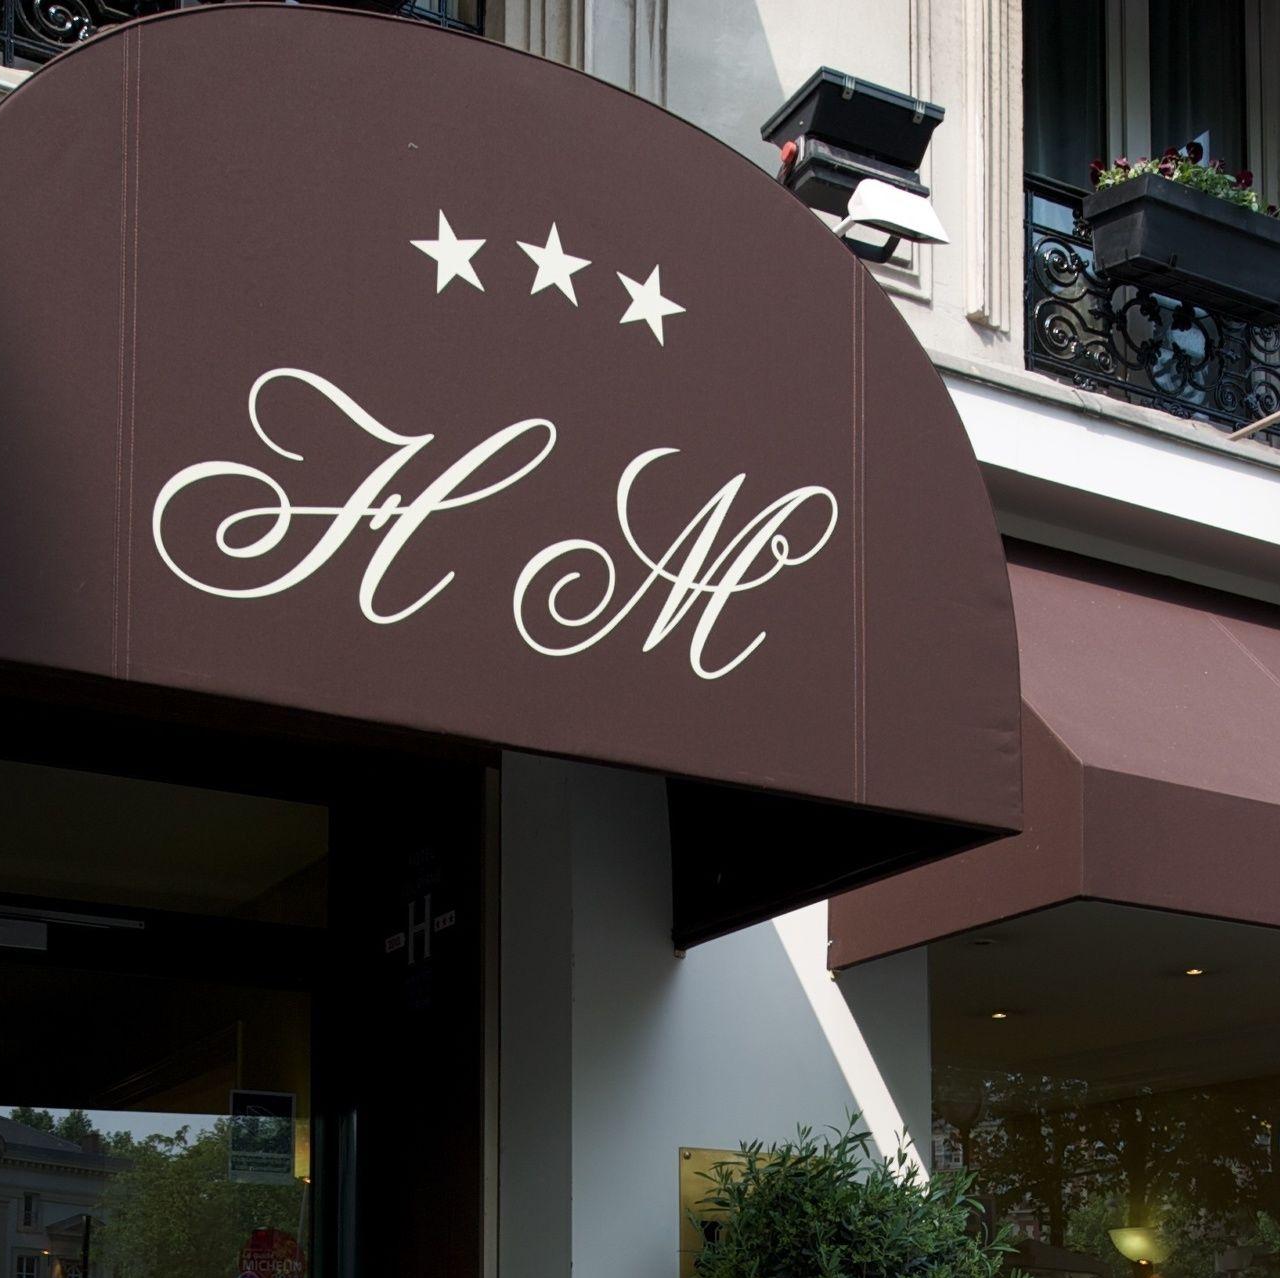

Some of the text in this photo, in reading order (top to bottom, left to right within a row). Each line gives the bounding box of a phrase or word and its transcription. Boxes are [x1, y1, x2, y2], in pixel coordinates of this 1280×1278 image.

[152, 367, 839, 680] H M
[242, 1257, 303, 1273] MICHELIN
